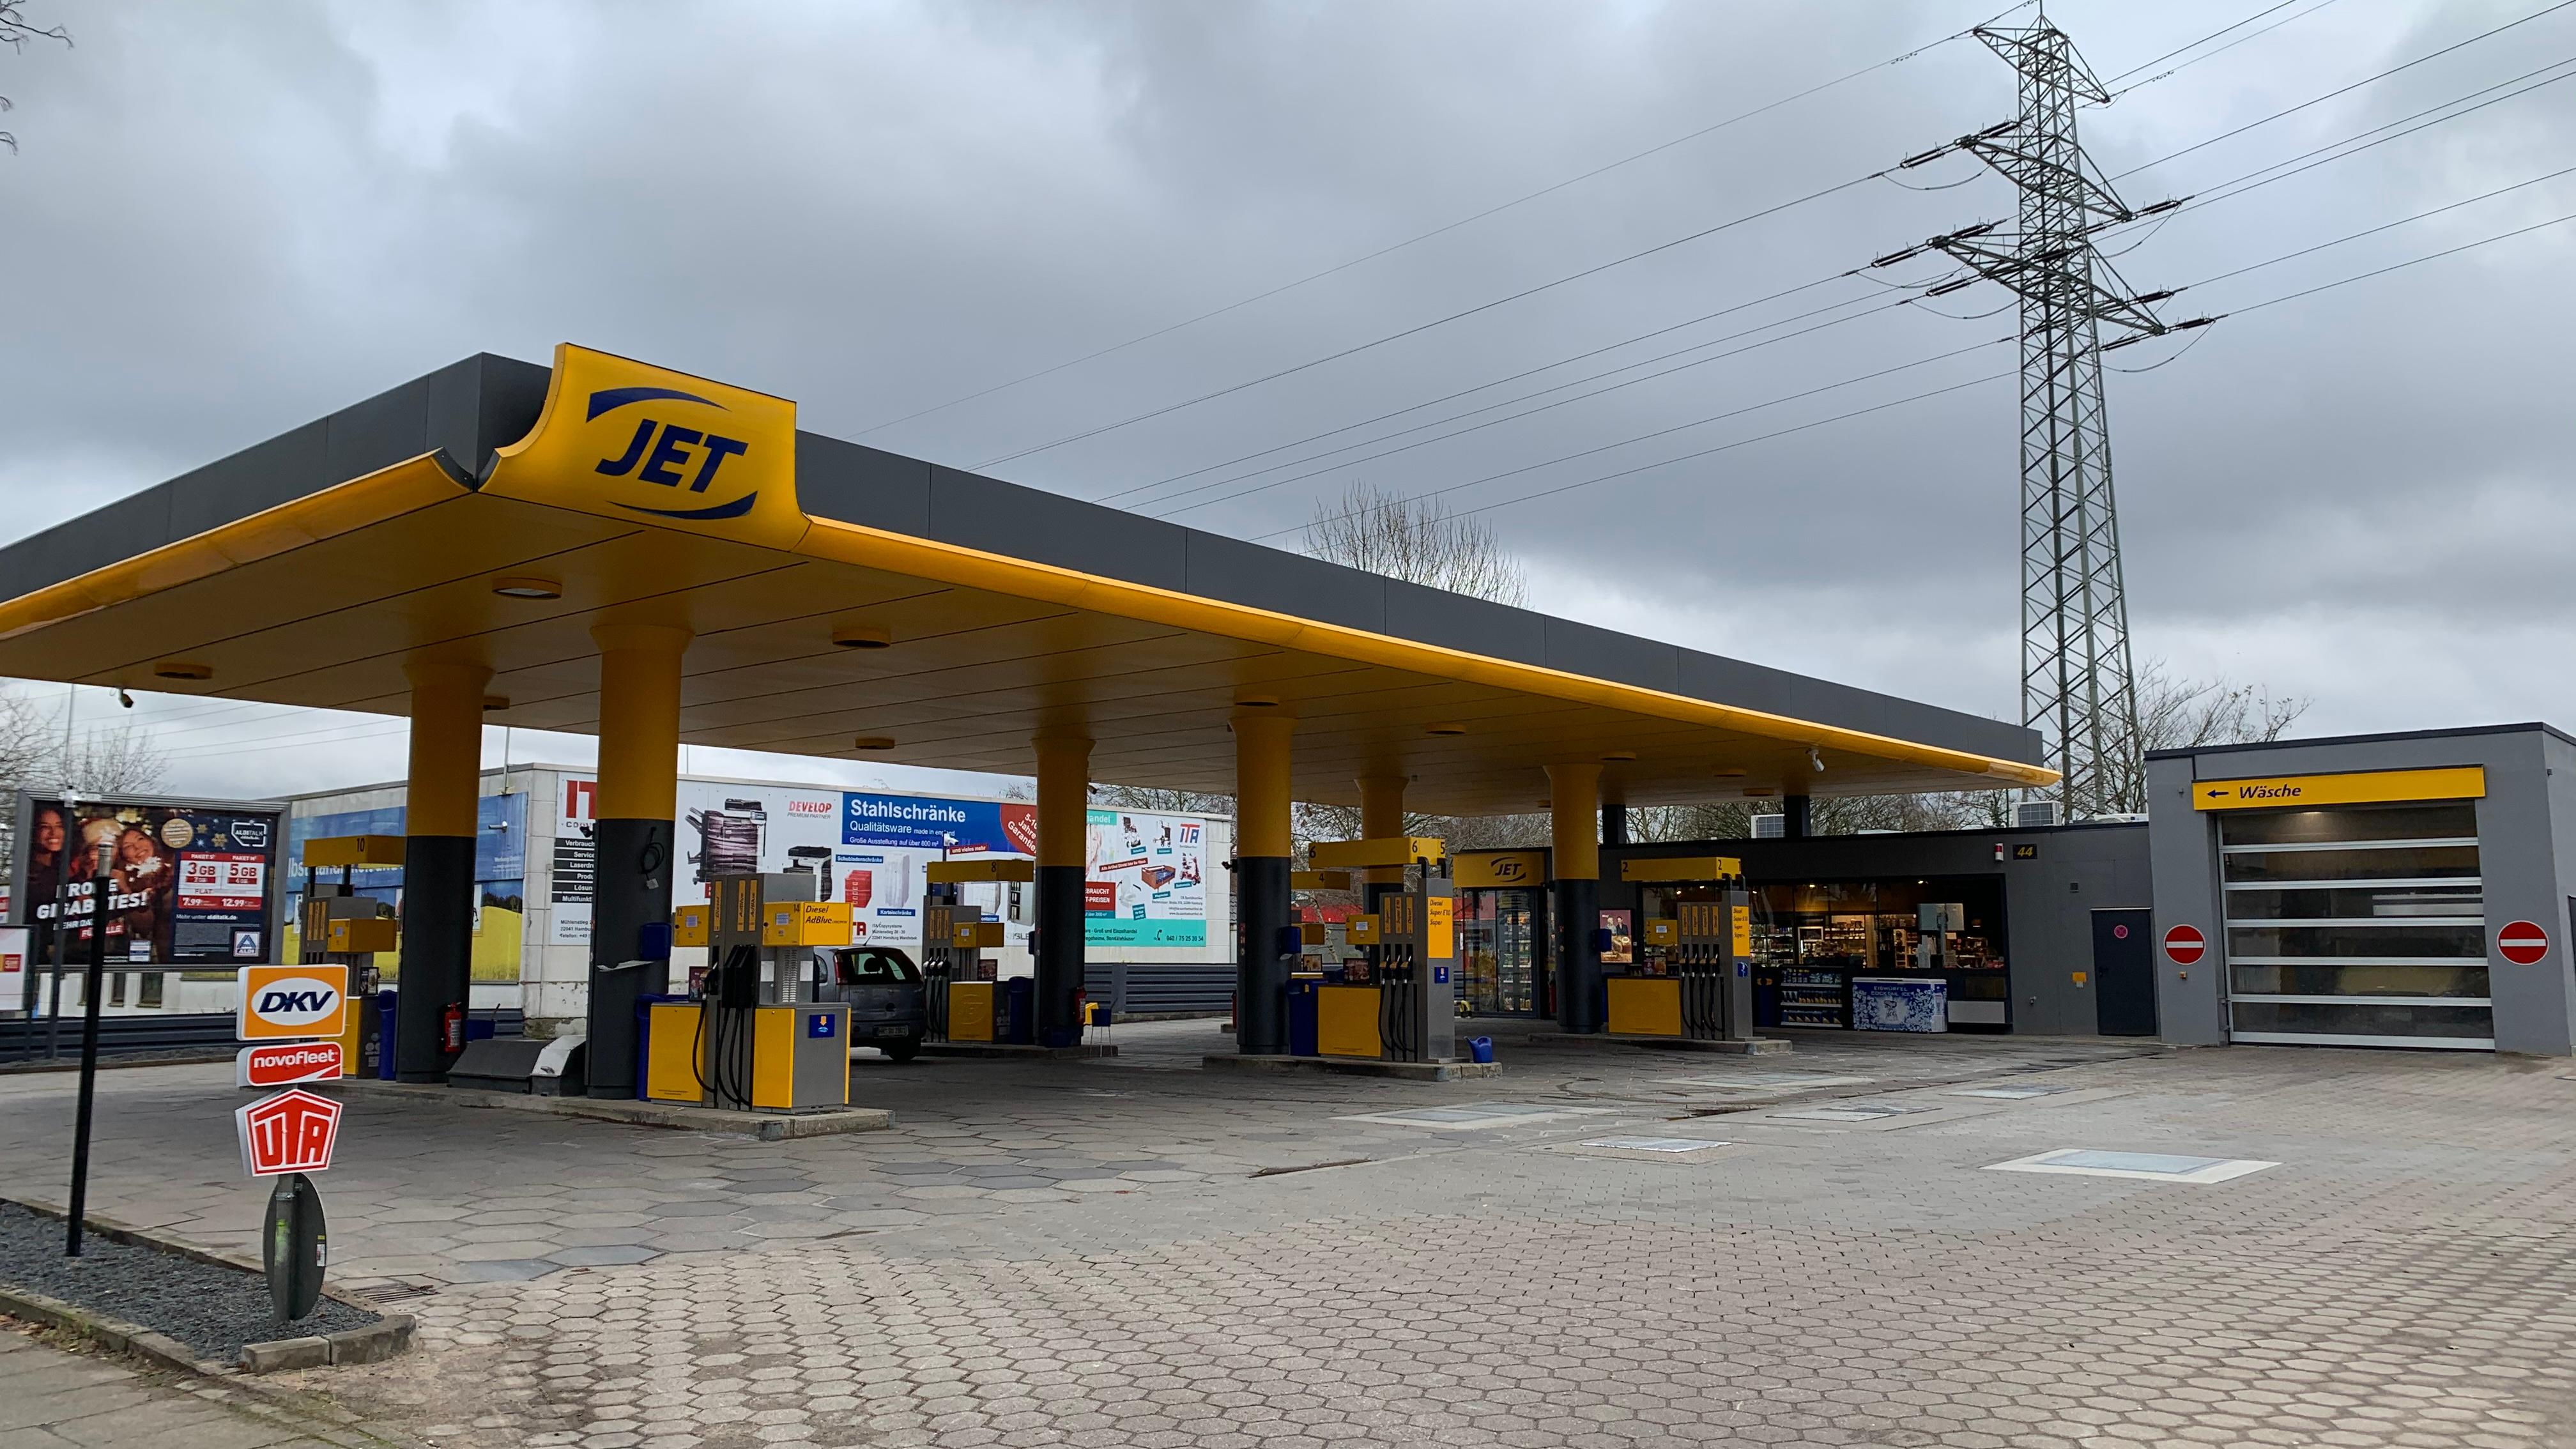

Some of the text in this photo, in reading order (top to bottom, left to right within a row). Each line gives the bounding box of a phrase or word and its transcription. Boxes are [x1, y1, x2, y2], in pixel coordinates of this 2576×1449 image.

[595, 418, 749, 493] JET
[2239, 783, 2301, 799] Wäsche
[789, 801, 832, 812] DEVELOP
[850, 799, 965, 822] Stahlschränke
[850, 820, 912, 834] Qualitätsware
[1018, 820, 1036, 839] Jahre
[1179, 823, 1200, 844] ITA
[356, 838, 365, 853] 10
[868, 838, 898, 847] Ausstellung
[1412, 840, 1418, 853] 6
[1440, 841, 1446, 855] 5
[1310, 845, 1317, 858] 6
[2017, 847, 2033, 857] 44
[188, 862, 215, 875] 3 GB
[230, 863, 257, 877] 5 GB
[991, 862, 997, 872] 8
[1495, 863, 1522, 876] JET
[1622, 861, 1629, 873] 2
[1717, 859, 1722, 870] 2
[1318, 873, 1324, 882] 4
[183, 897, 202, 906] 7.99
[222, 898, 244, 907] 12.99
[677, 907, 683, 916] 12
[806, 905, 829, 913] Diesel
[1429, 908, 1442, 917] Super
[258, 990, 334, 1013] DKV
[254, 1049, 335, 1068] novofleet
[254, 1097, 334, 1167] UTA
